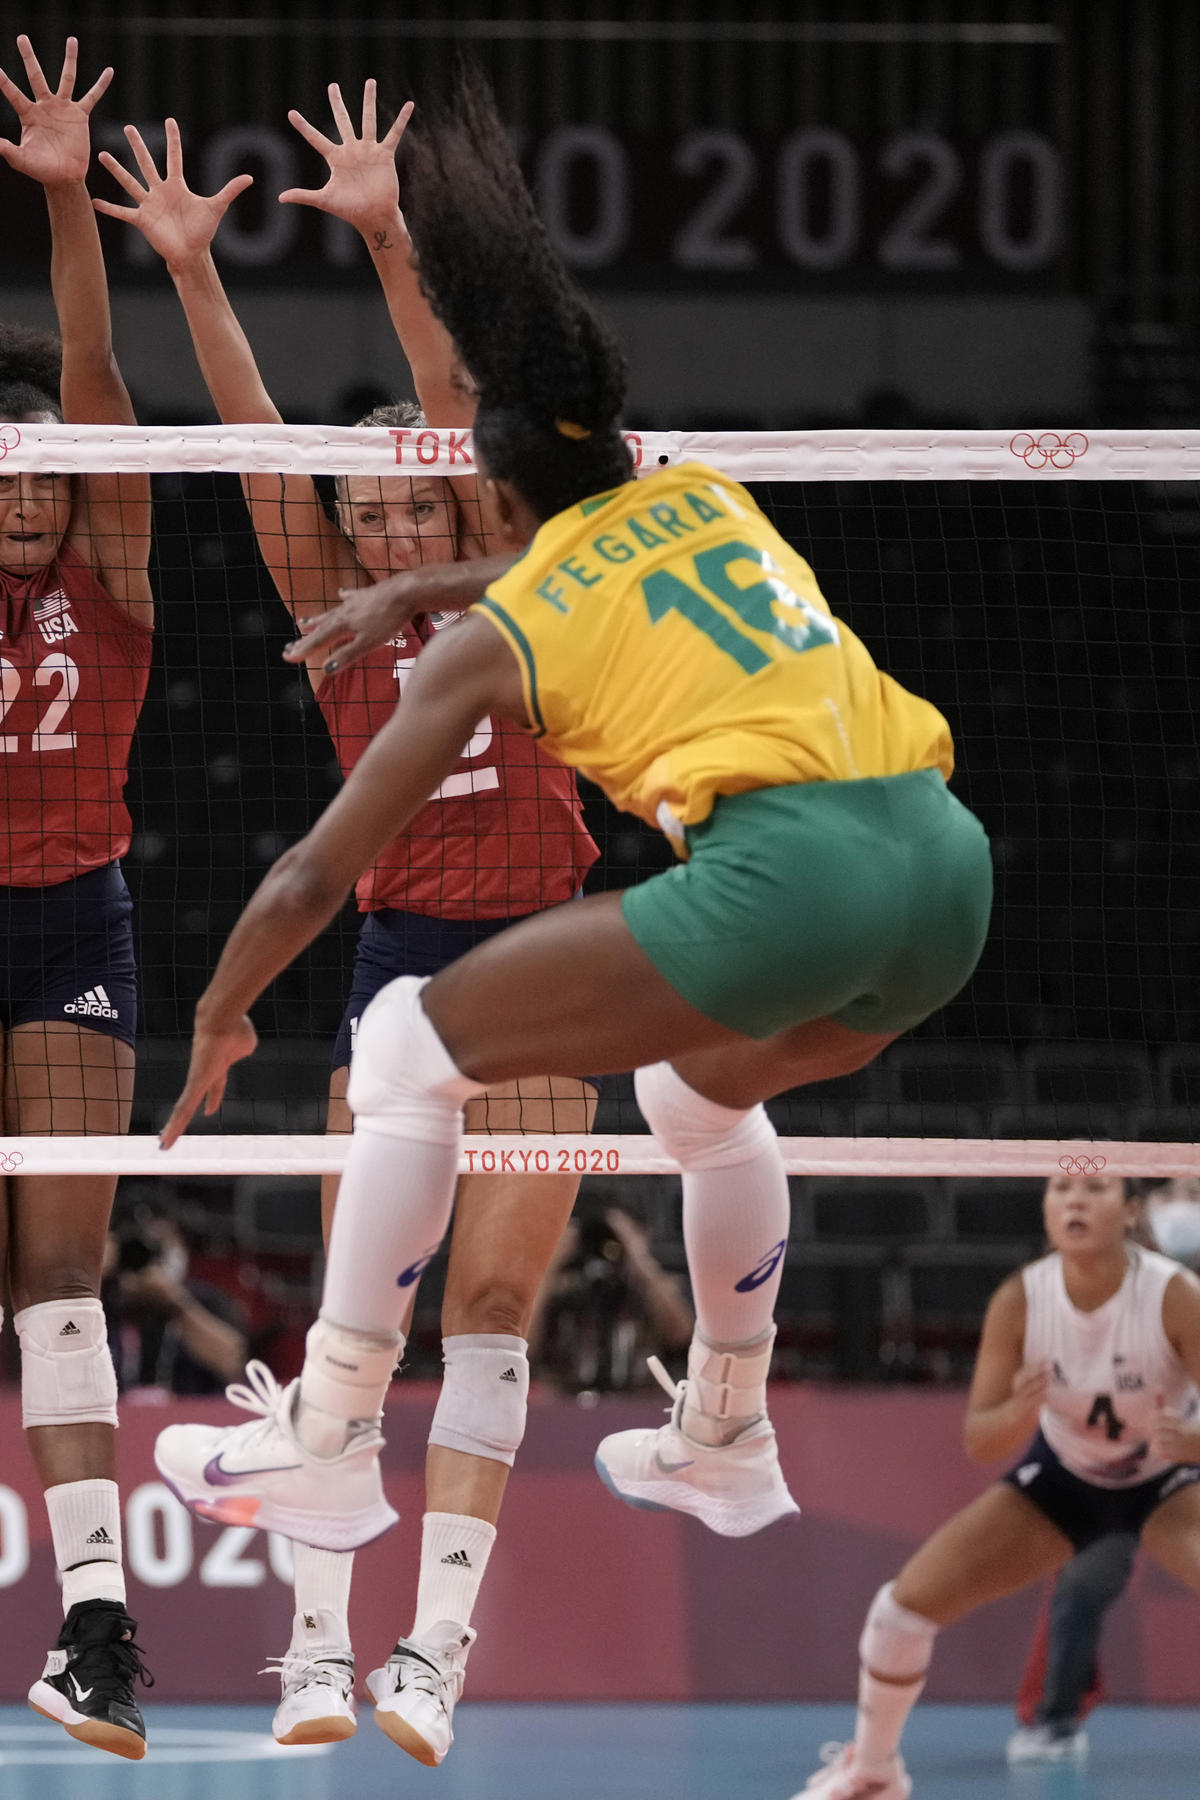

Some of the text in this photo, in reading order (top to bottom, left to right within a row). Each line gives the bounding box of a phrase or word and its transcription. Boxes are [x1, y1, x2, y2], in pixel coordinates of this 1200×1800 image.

[670, 127, 1063, 272] 2020
[388, 430, 474, 465] TOK
[640, 540, 841, 676] 16
[38, 613, 79, 644] USA
[63, 1001, 119, 1020] adidas
[464, 1149, 620, 1172] TOKYO 2020
[1087, 1392, 1126, 1441] 4
[440, 1557, 472, 1569] adidas
